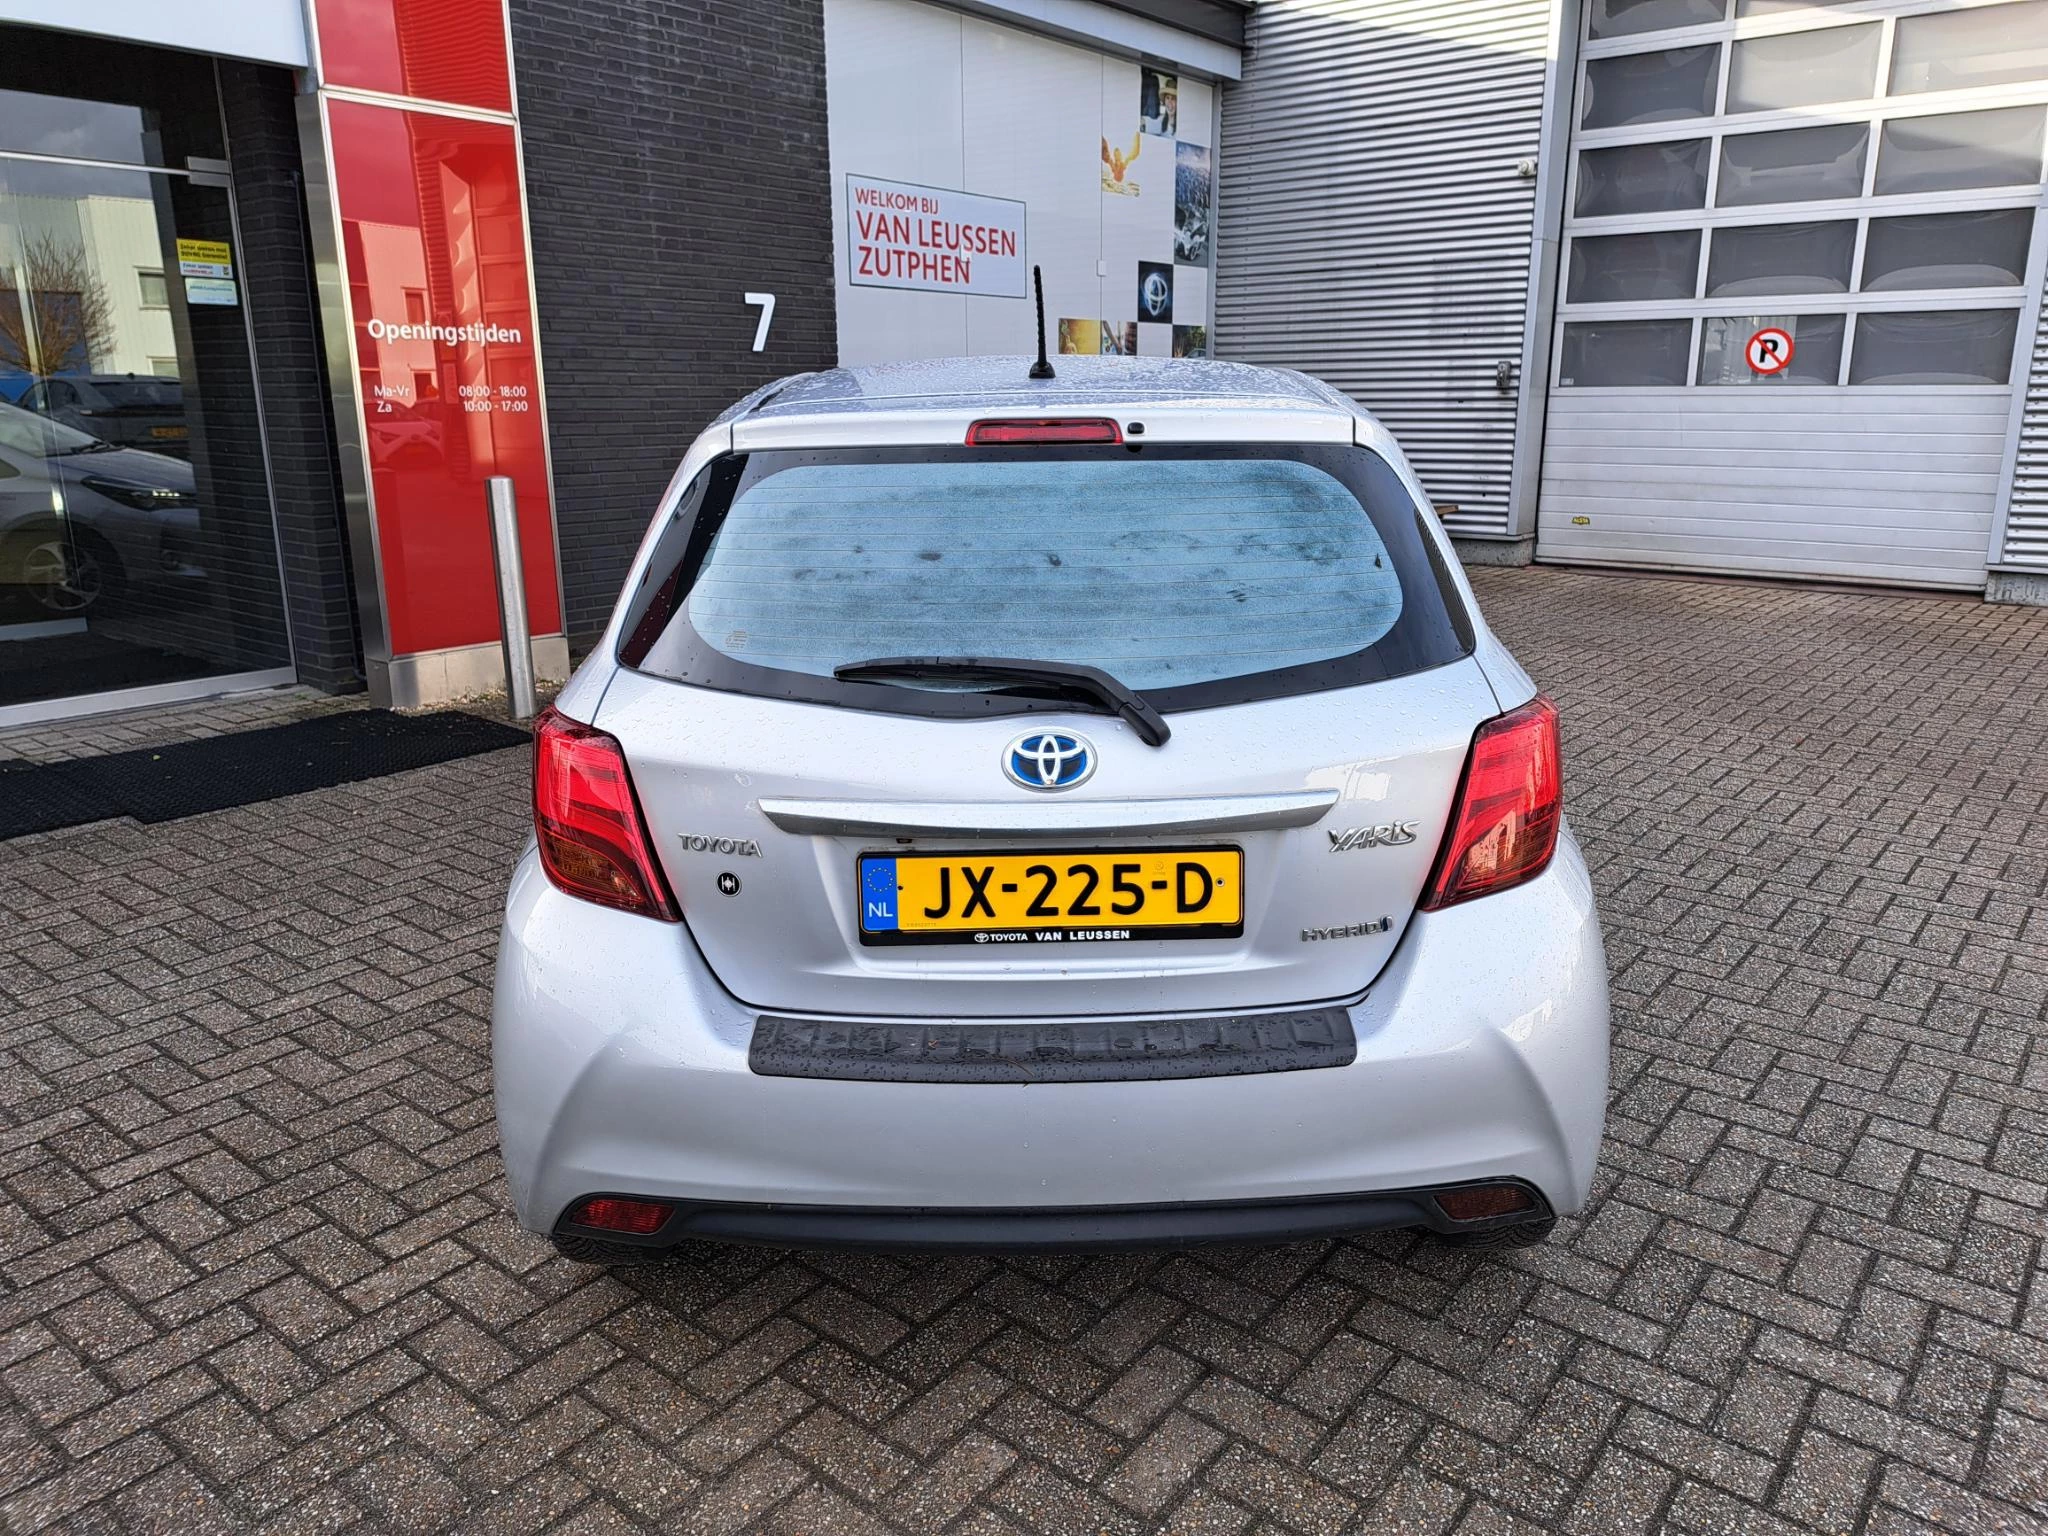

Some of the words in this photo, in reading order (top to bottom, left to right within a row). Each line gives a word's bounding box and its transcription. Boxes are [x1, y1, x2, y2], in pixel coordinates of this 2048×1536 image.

[855, 187, 918, 212] WELKOM
[921, 198, 939, 215] BIJ
[856, 210, 911, 245] VAN
[918, 218, 1016, 257] LEUSSEN
[858, 246, 971, 284] ZUTPHEN
[367, 318, 522, 347] Openingstijden
[744, 292, 776, 352] 7
[1759, 338, 1779, 363] P
[374, 384, 410, 397] Ma-Vr
[458, 385, 491, 398] 08:00
[499, 385, 527, 398] 18:00
[377, 400, 393, 413] Za
[463, 400, 492, 413] 10:00
[501, 400, 529, 413] 17:00
[677, 832, 764, 858] TOYOTA
[924, 862, 1214, 919] JX-225-D
[868, 902, 893, 918] NL
[990, 932, 1028, 942] TOYOTA
[1035, 931, 1062, 942] VAN
[1069, 930, 1131, 941] LEUSSEN
[1301, 919, 1383, 942] HYBRID
